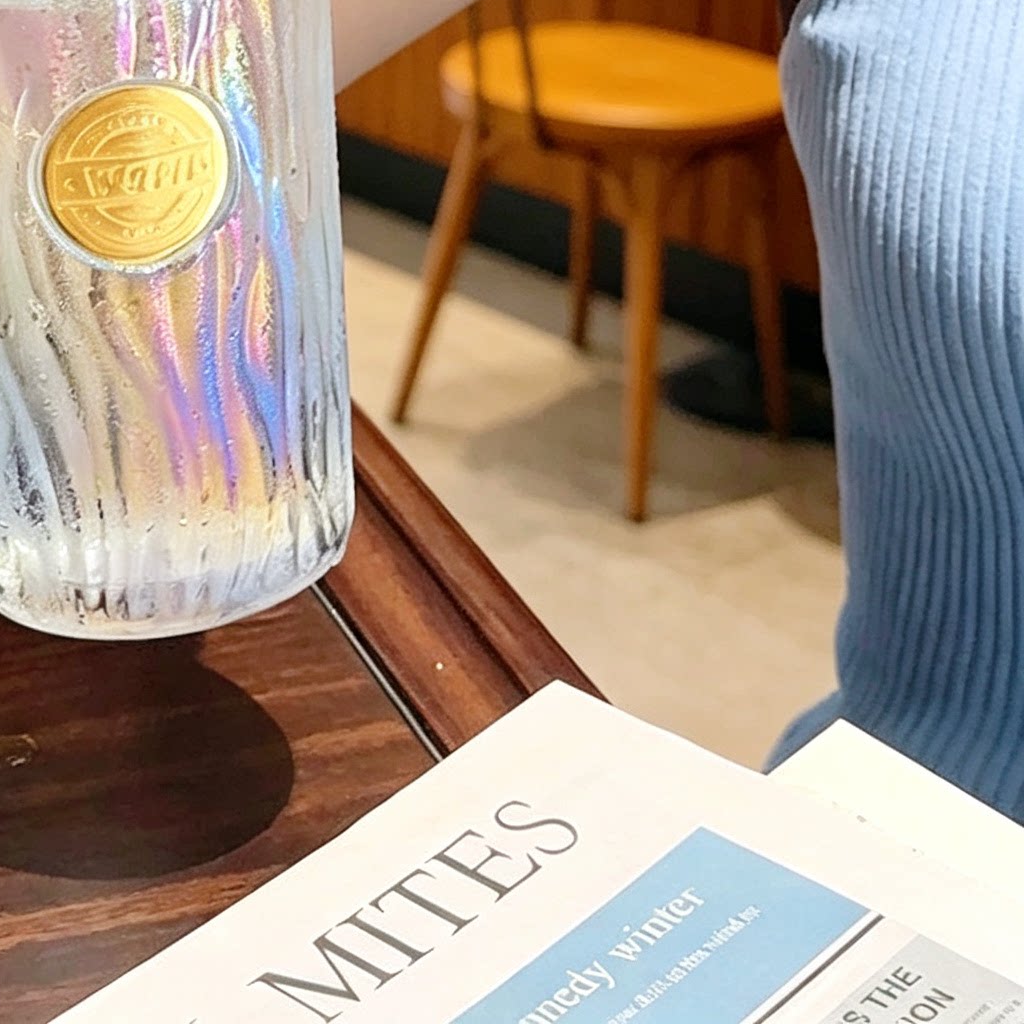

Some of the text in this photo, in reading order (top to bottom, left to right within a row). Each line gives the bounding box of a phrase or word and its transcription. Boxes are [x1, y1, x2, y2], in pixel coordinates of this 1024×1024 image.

[247, 800, 578, 1023] MITES
[608, 887, 705, 962] winter
[859, 966, 922, 1008] THE
